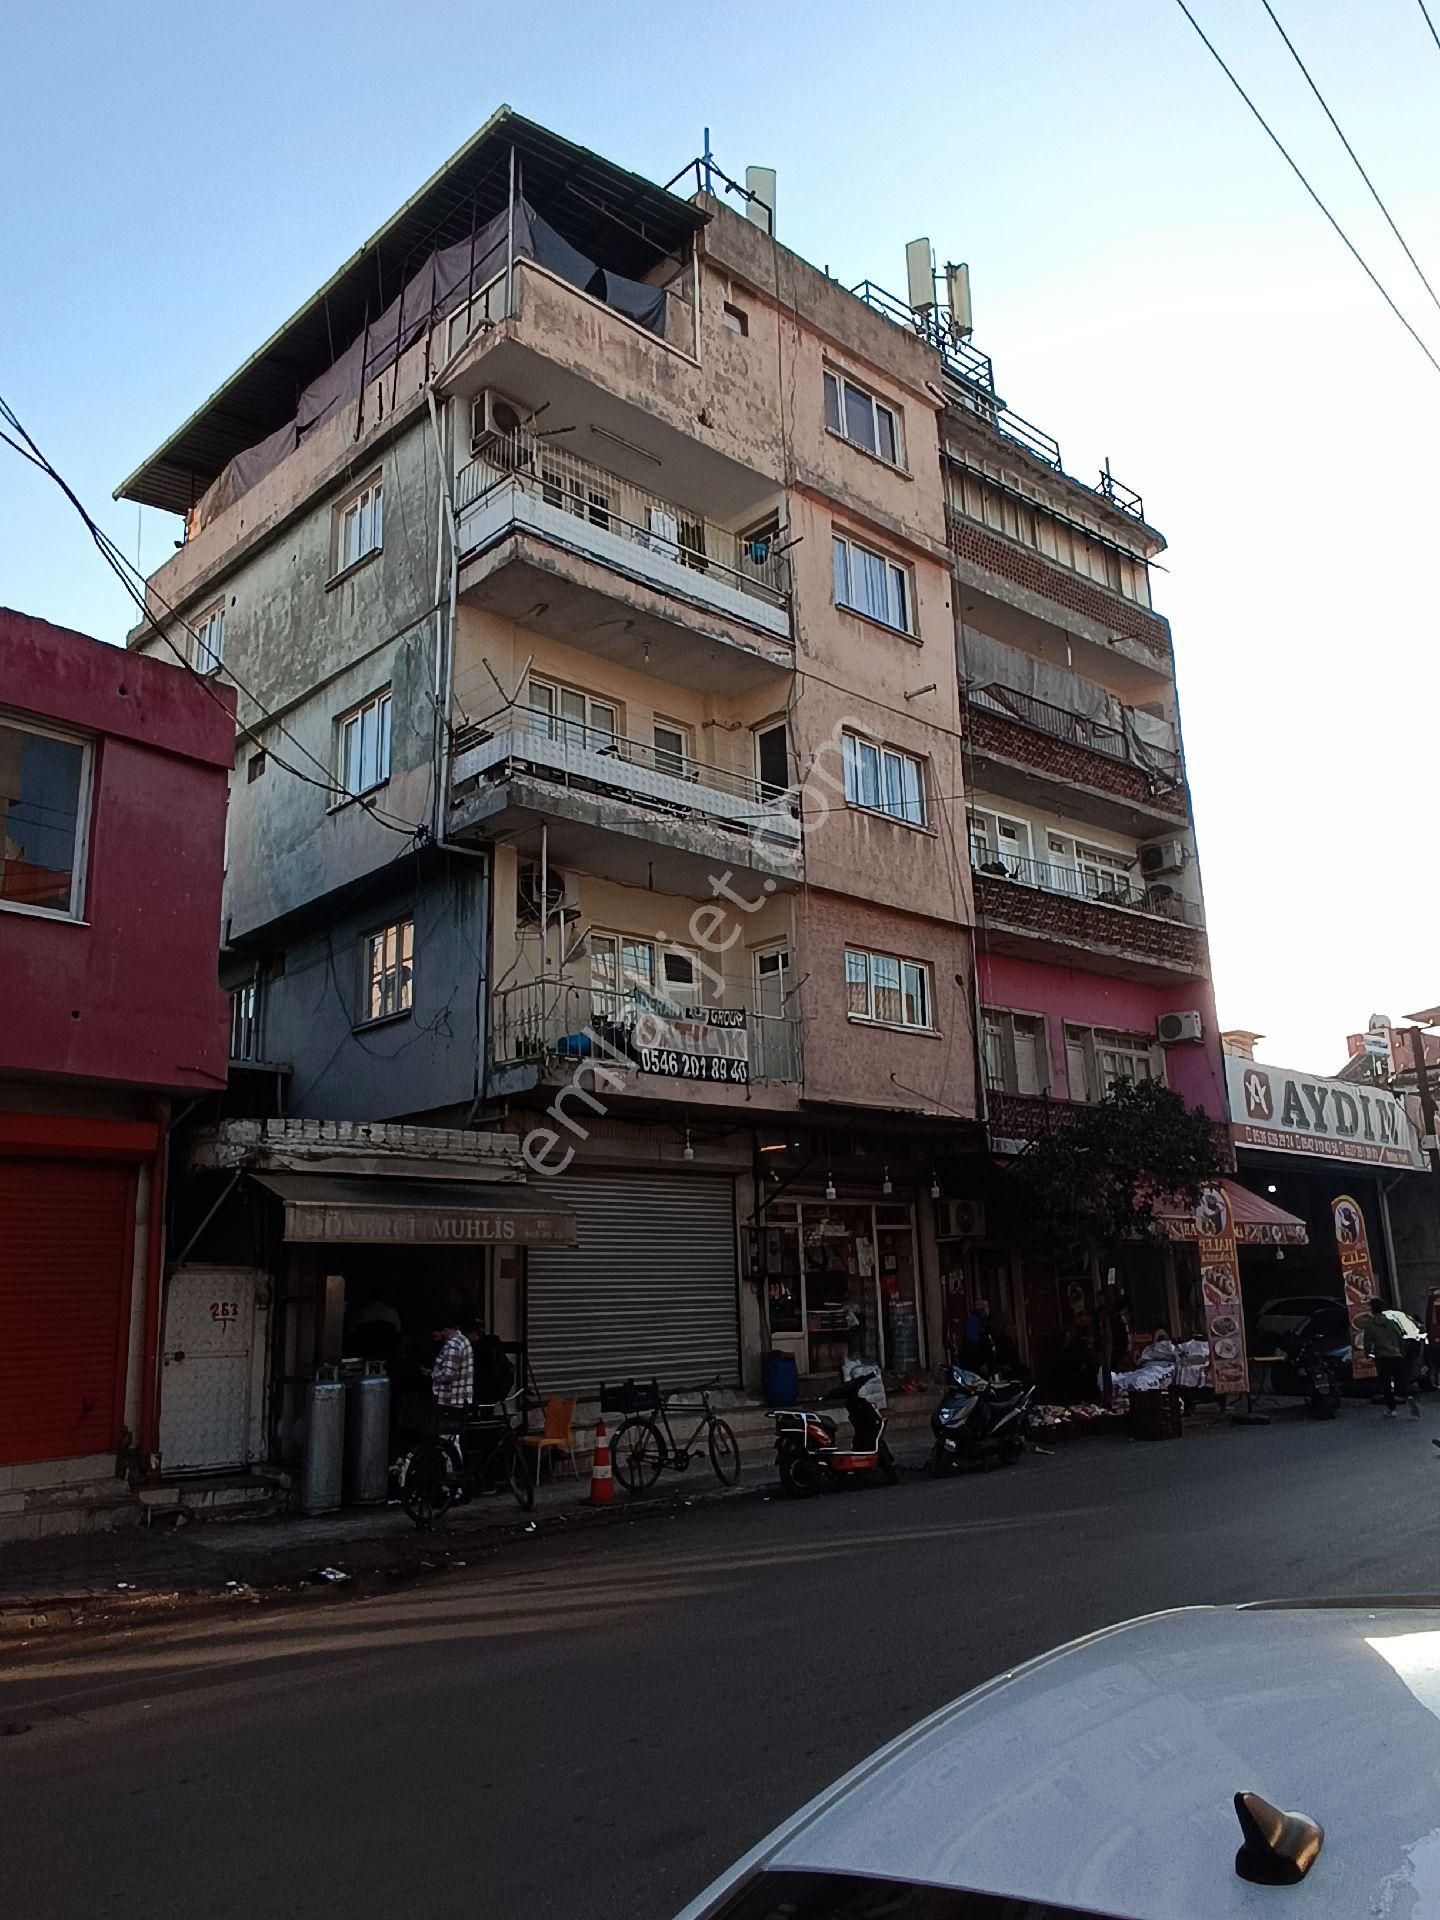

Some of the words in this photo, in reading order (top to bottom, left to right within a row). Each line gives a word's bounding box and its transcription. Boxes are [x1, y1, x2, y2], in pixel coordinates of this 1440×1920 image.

[710, 1009, 743, 1027] GROUP
[641, 1048, 678, 1075] 0546
[681, 1054, 706, 1078] 201
[711, 1058, 727, 1079] 89
[731, 1060, 747, 1082] 40
[1280, 1080, 1400, 1146] AYDIN
[431, 1214, 516, 1240] MUHLİS
[209, 1302, 239, 1317] 263
